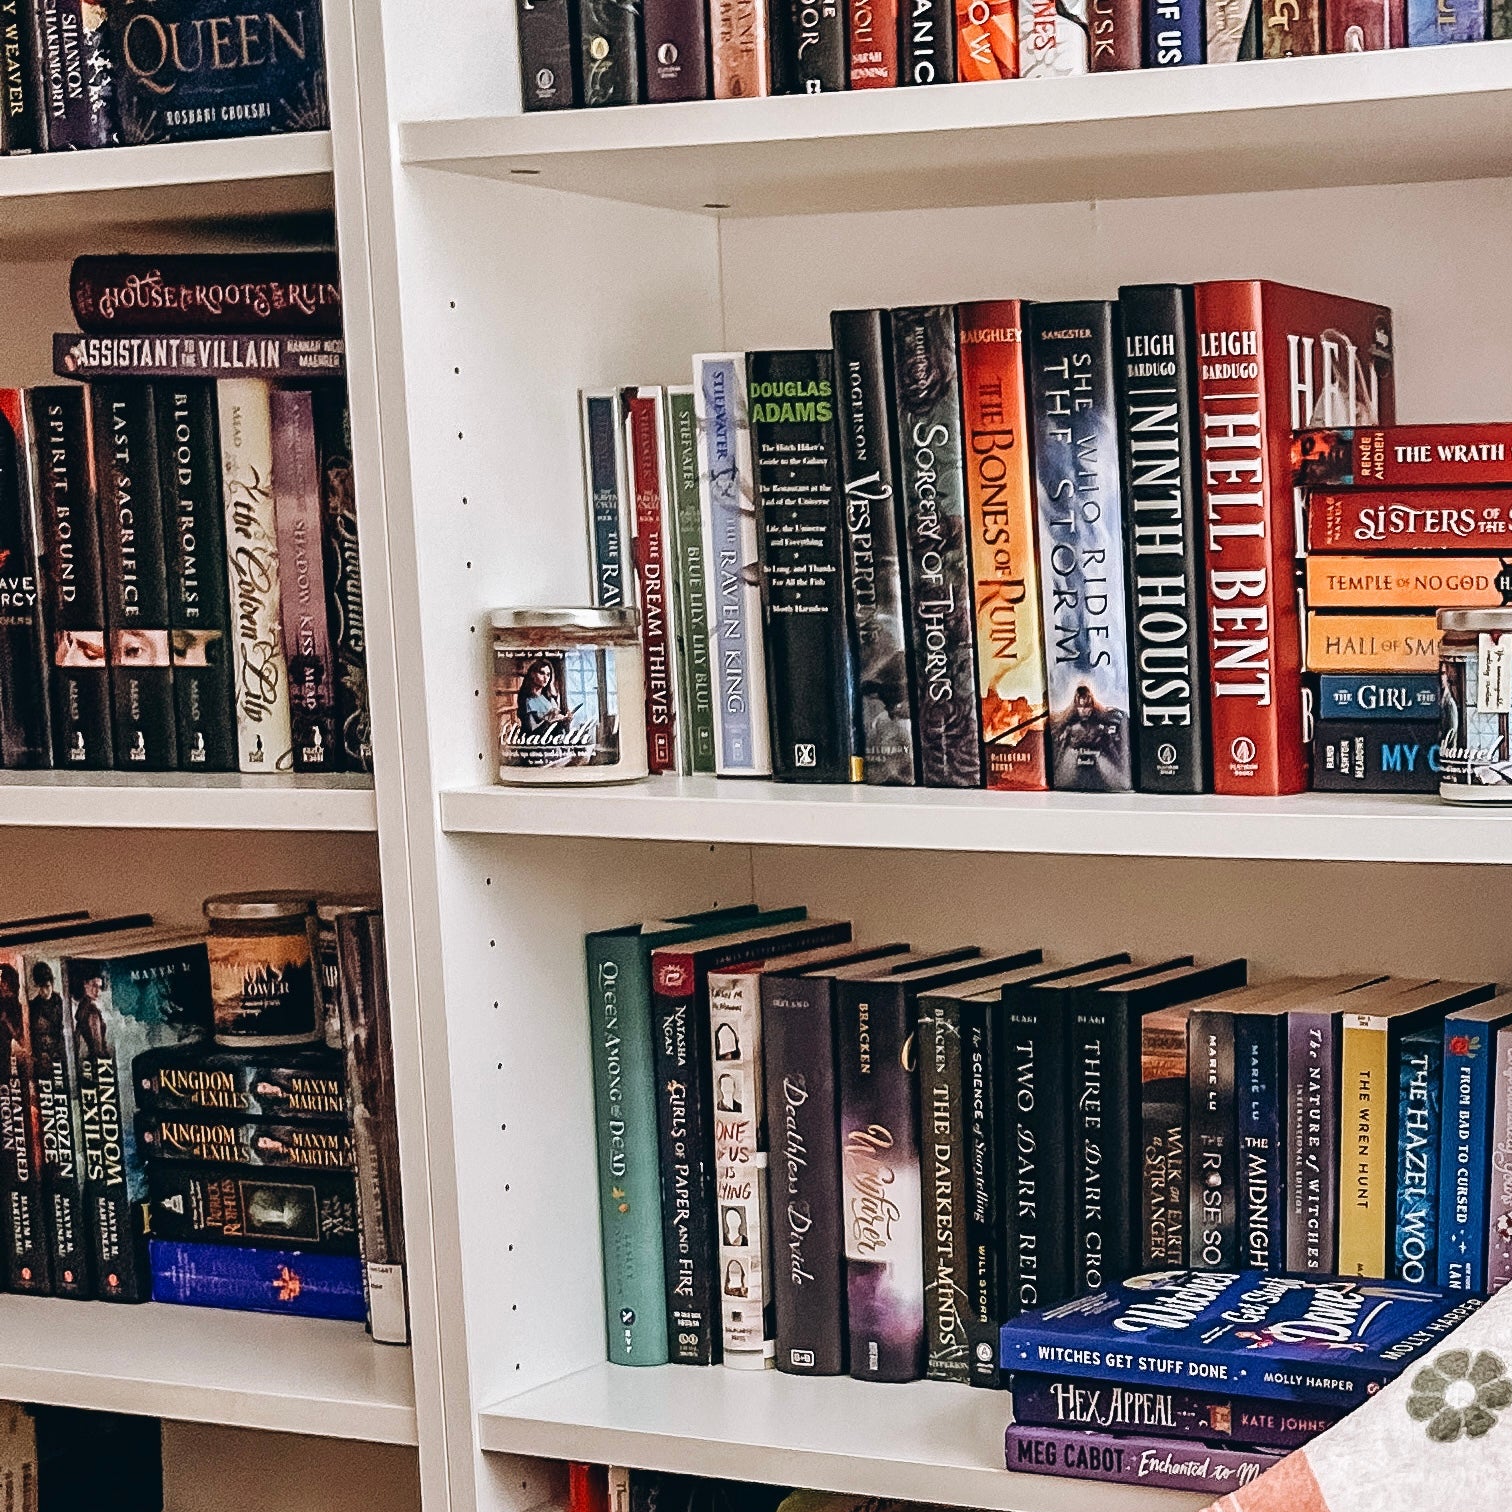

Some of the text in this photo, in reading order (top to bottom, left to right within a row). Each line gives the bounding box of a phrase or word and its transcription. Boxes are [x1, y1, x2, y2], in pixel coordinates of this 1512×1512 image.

[6, 23, 24, 117] WEAVER
[122, 10, 306, 95] QUEEN
[1157, 31, 1183, 64] US
[77, 338, 280, 369] ASSISTANT VILLAIN
[1041, 328, 1093, 340] SANGSTER
[1126, 334, 1175, 358] LEIGH
[1200, 331, 1257, 358] LEIGH
[750, 381, 832, 398] DOUGLAS
[1127, 361, 1176, 378] BARDUGO
[1202, 362, 1258, 381] BARDUGO
[231, 405, 243, 448] MEAD
[752, 401, 833, 423] ADAMS
[1374, 432, 1385, 481] AHDIEH
[1394, 445, 1433, 464] THE
[1437, 443, 1505, 463] WRATH
[49, 405, 76, 603] SPIRIT BOUND
[113, 402, 141, 617] LAST SACRIFICE
[174, 394, 200, 618] BLOOD PROMISE
[1071, 352, 1111, 669] SHE WHO RIDES
[1354, 504, 1476, 541] SISTERS
[1477, 521, 1507, 533] THE
[1482, 507, 1501, 520] OF
[294, 520, 312, 605] SHADOW
[649, 532, 659, 558] THE
[913, 421, 955, 702] SORCERY OF THORNS
[971, 427, 1026, 661] BONES RUIN
[1129, 402, 1191, 728] NINTH HOUSE
[1203, 409, 1271, 707] HELL BENT
[1051, 478, 1081, 664] STORM
[1327, 574, 1489, 591] TEMPLE NO GOD
[644, 564, 664, 638] DREAM
[719, 550, 746, 714] RAVEN KING
[1325, 636, 1376, 655] HALL
[303, 666, 317, 711] MEAD
[648, 642, 668, 725] THIEVES
[696, 671, 710, 713] BLUE
[1357, 684, 1413, 711] GIRL
[1354, 736, 1364, 779] MEADOWS
[1382, 744, 1420, 772] MY
[674, 1004, 687, 1067] NATASHA
[858, 1002, 871, 1075] BRACKEN
[159, 1068, 235, 1098] KINGDOM
[291, 1078, 339, 1096] MAXYM
[932, 1008, 951, 1135] BRACKEN THE
[1208, 1035, 1218, 1112] MARIE LU
[1250, 1044, 1260, 1121] MARIE LU
[38, 1079, 59, 1164] PRINCE
[81, 1060, 104, 1181] OF EXILES
[97, 1057, 124, 1187] KINGDOM
[669, 1081, 688, 1139] GIRLS
[1016, 1039, 1037, 1219] TWO DARK
[1079, 1039, 1102, 1220] THREE DARK
[1404, 1054, 1429, 1204] THE HAZEL
[54, 1093, 75, 1179] FROZEN
[161, 1121, 235, 1151] KINGDOM
[292, 1131, 339, 1150] MAXYM
[727, 1146, 750, 1163] US
[1166, 1126, 1182, 1181] WALK
[1244, 1137, 1269, 1149] THE
[1305, 1029, 1322, 1269] The NATURE of WITCHES
[1356, 1070, 1371, 1209] THE WREN HUNT
[1455, 1066, 1471, 1225] FROM BAD TO CURSED
[723, 1166, 736, 1179] IS
[782, 1072, 815, 1286] Deathless Divide
[972, 1052, 987, 1276] SCIENCE WILL
[673, 1164, 691, 1227] PAPER
[673, 1257, 694, 1298] FIRE
[1112, 1270, 1241, 1333] Witches
[1221, 1302, 1270, 1323] Get
[1267, 1287, 1366, 1343] Done
[1038, 1345, 1228, 1381] WITCHES GET STUFF DONE
[1379, 1330, 1441, 1361] MOLLY
[1050, 1383, 1177, 1427] HEX APPEAL
[1263, 1371, 1355, 1393] MOLLY HARPER
[1240, 1413, 1275, 1430] KATE
[1017, 1439, 1211, 1480] MEG CABOT Enchanted
